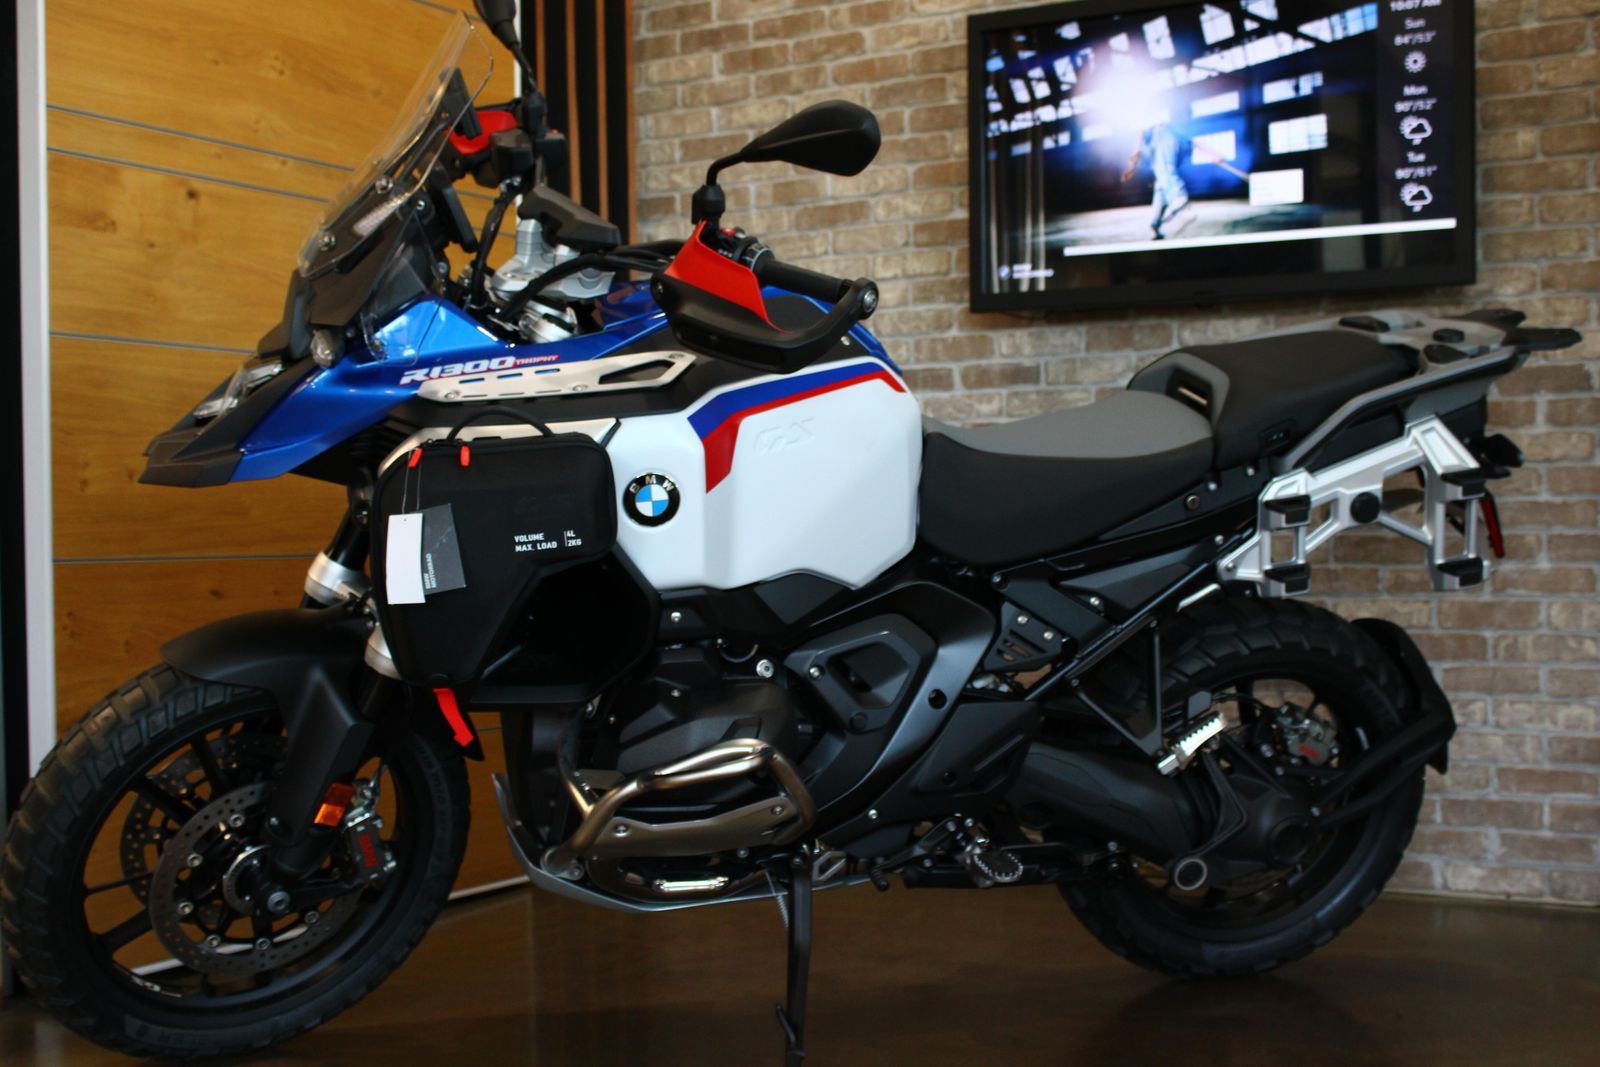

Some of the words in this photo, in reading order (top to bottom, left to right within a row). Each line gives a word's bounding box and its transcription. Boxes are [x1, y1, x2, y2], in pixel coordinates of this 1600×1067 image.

[1404, 18, 1426, 30] Sun
[1403, 85, 1428, 97] Mon
[1406, 151, 1426, 163] Tue
[400, 356, 516, 385] R1300
[515, 354, 559, 366] TROPHY
[629, 475, 674, 493] BMW
[514, 533, 545, 543] VOLUME
[537, 541, 558, 550] LOAD
[567, 538, 582, 547] 2KG
